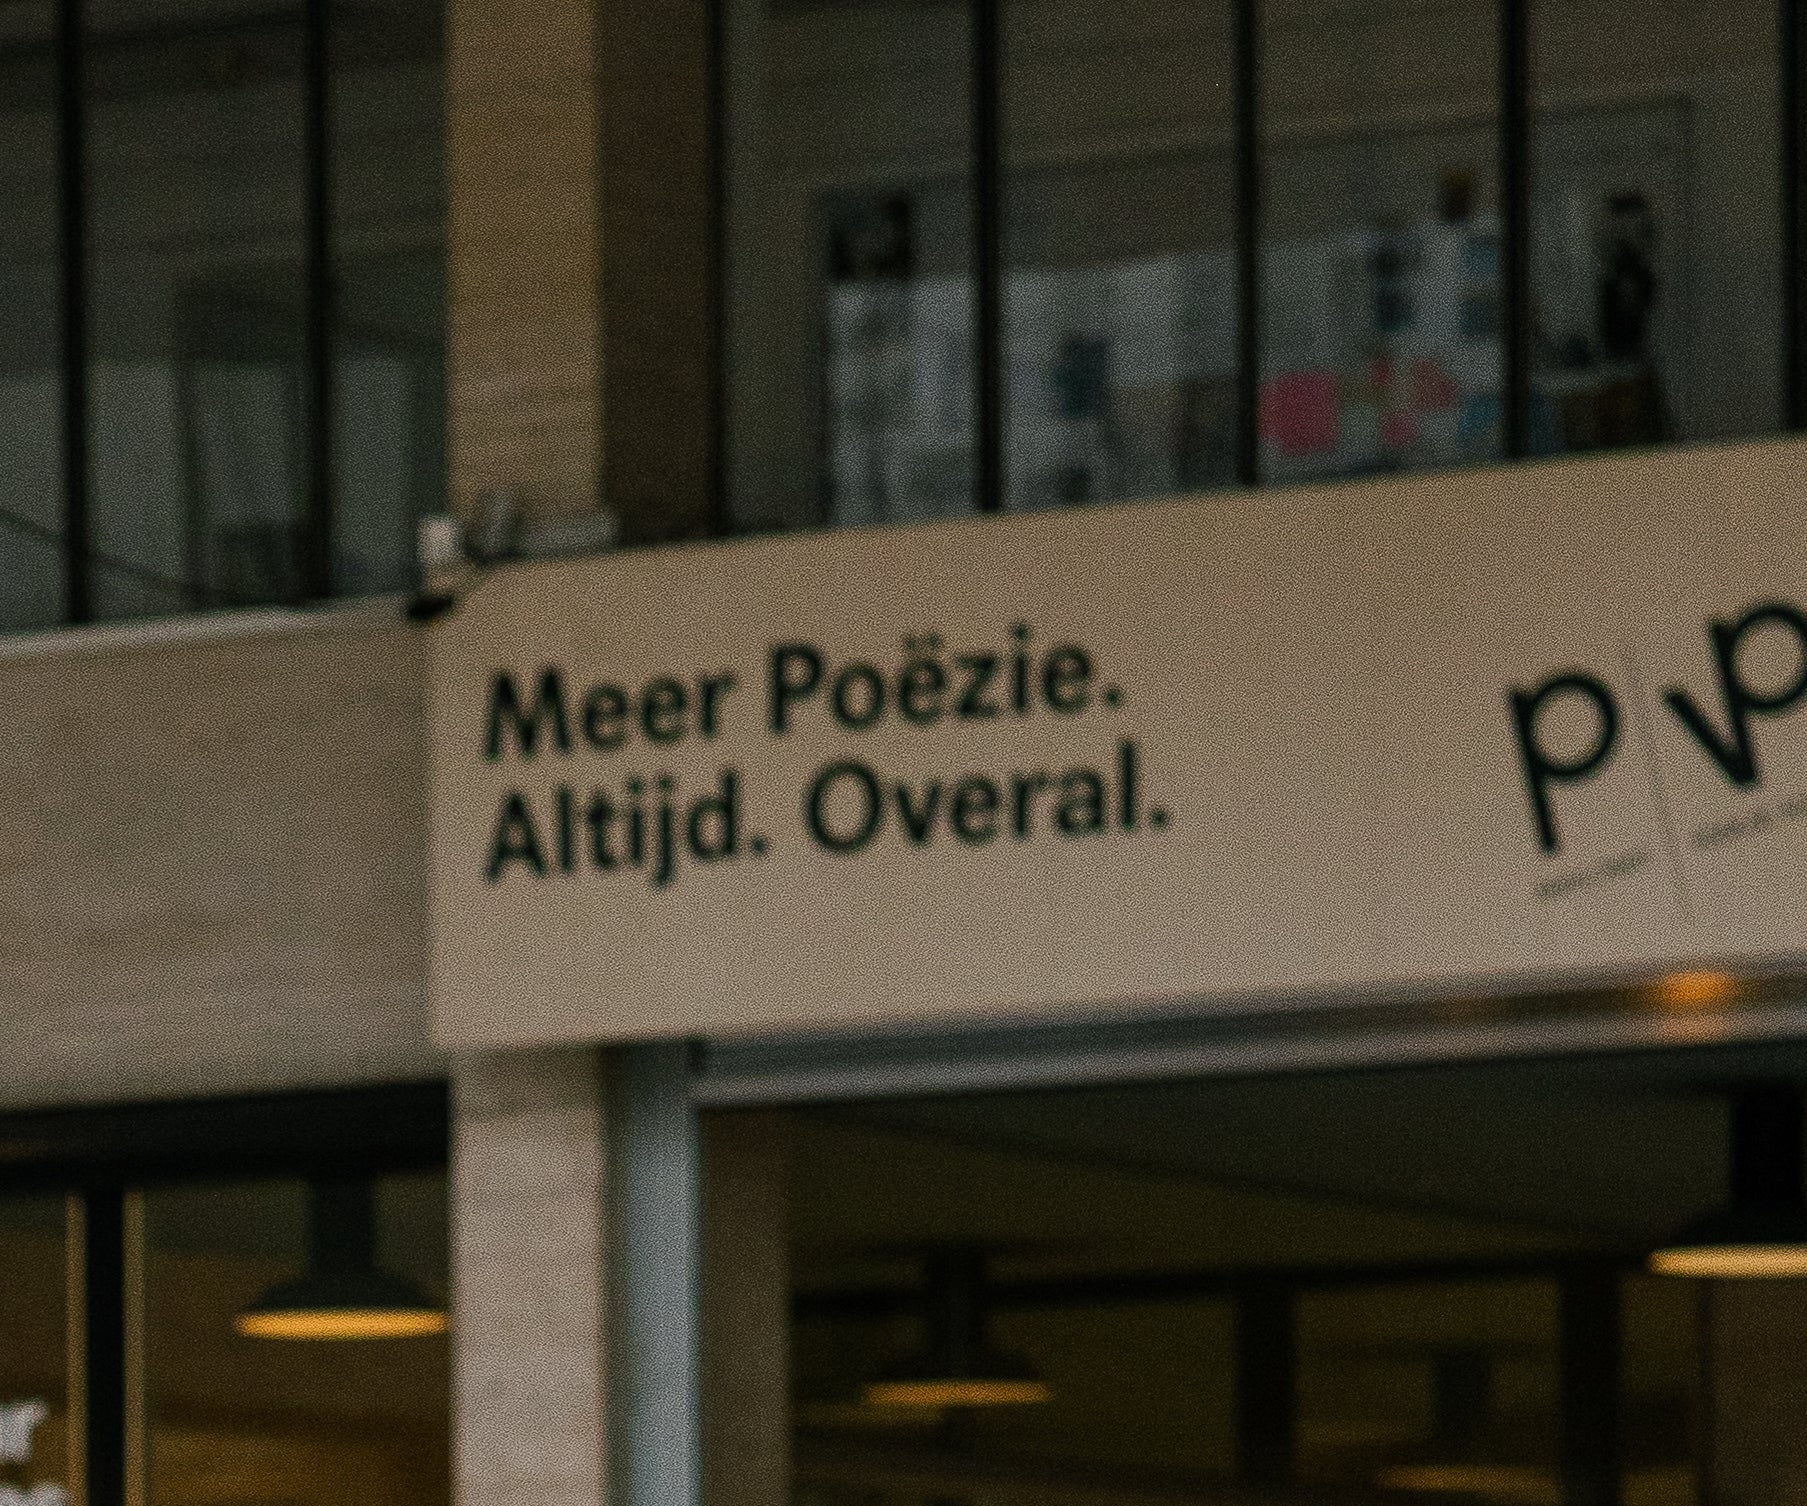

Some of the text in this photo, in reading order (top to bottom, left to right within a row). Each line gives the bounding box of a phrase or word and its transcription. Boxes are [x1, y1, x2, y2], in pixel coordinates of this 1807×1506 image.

[483, 618, 1126, 763] Meer Poëzie.
[484, 738, 1172, 889] Altijd. Overal.
